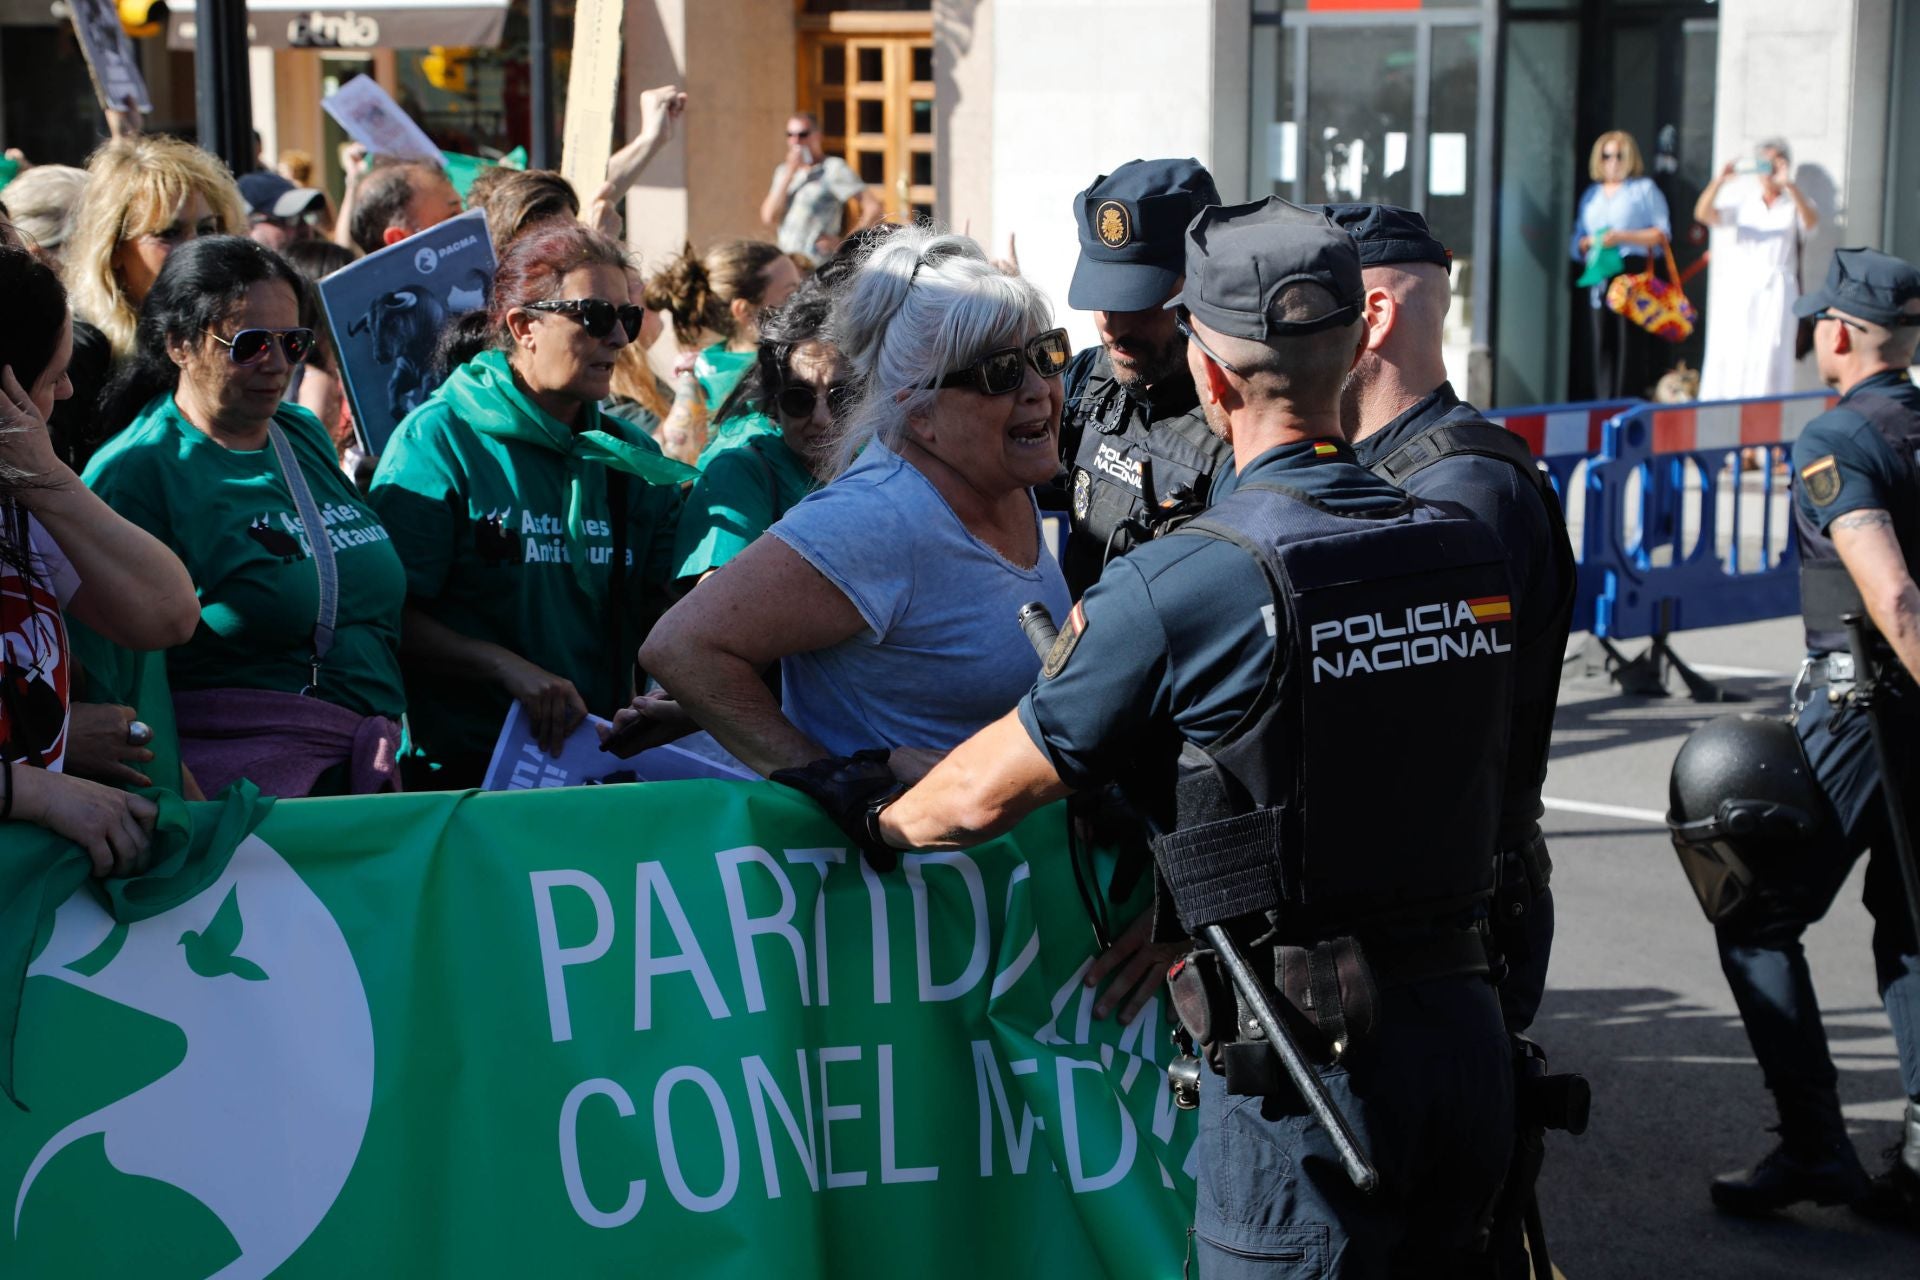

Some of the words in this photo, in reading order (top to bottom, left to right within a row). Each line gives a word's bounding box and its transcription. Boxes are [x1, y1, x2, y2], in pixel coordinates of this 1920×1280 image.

[438, 235, 478, 259] PACMA
[1098, 442, 1140, 474] POLIA
[521, 509, 610, 537] Astues
[525, 537, 633, 566] Antitura
[1312, 628, 1512, 684] NACIONAL
[558, 1048, 820, 1229] CON
[817, 1043, 940, 1189] EL
